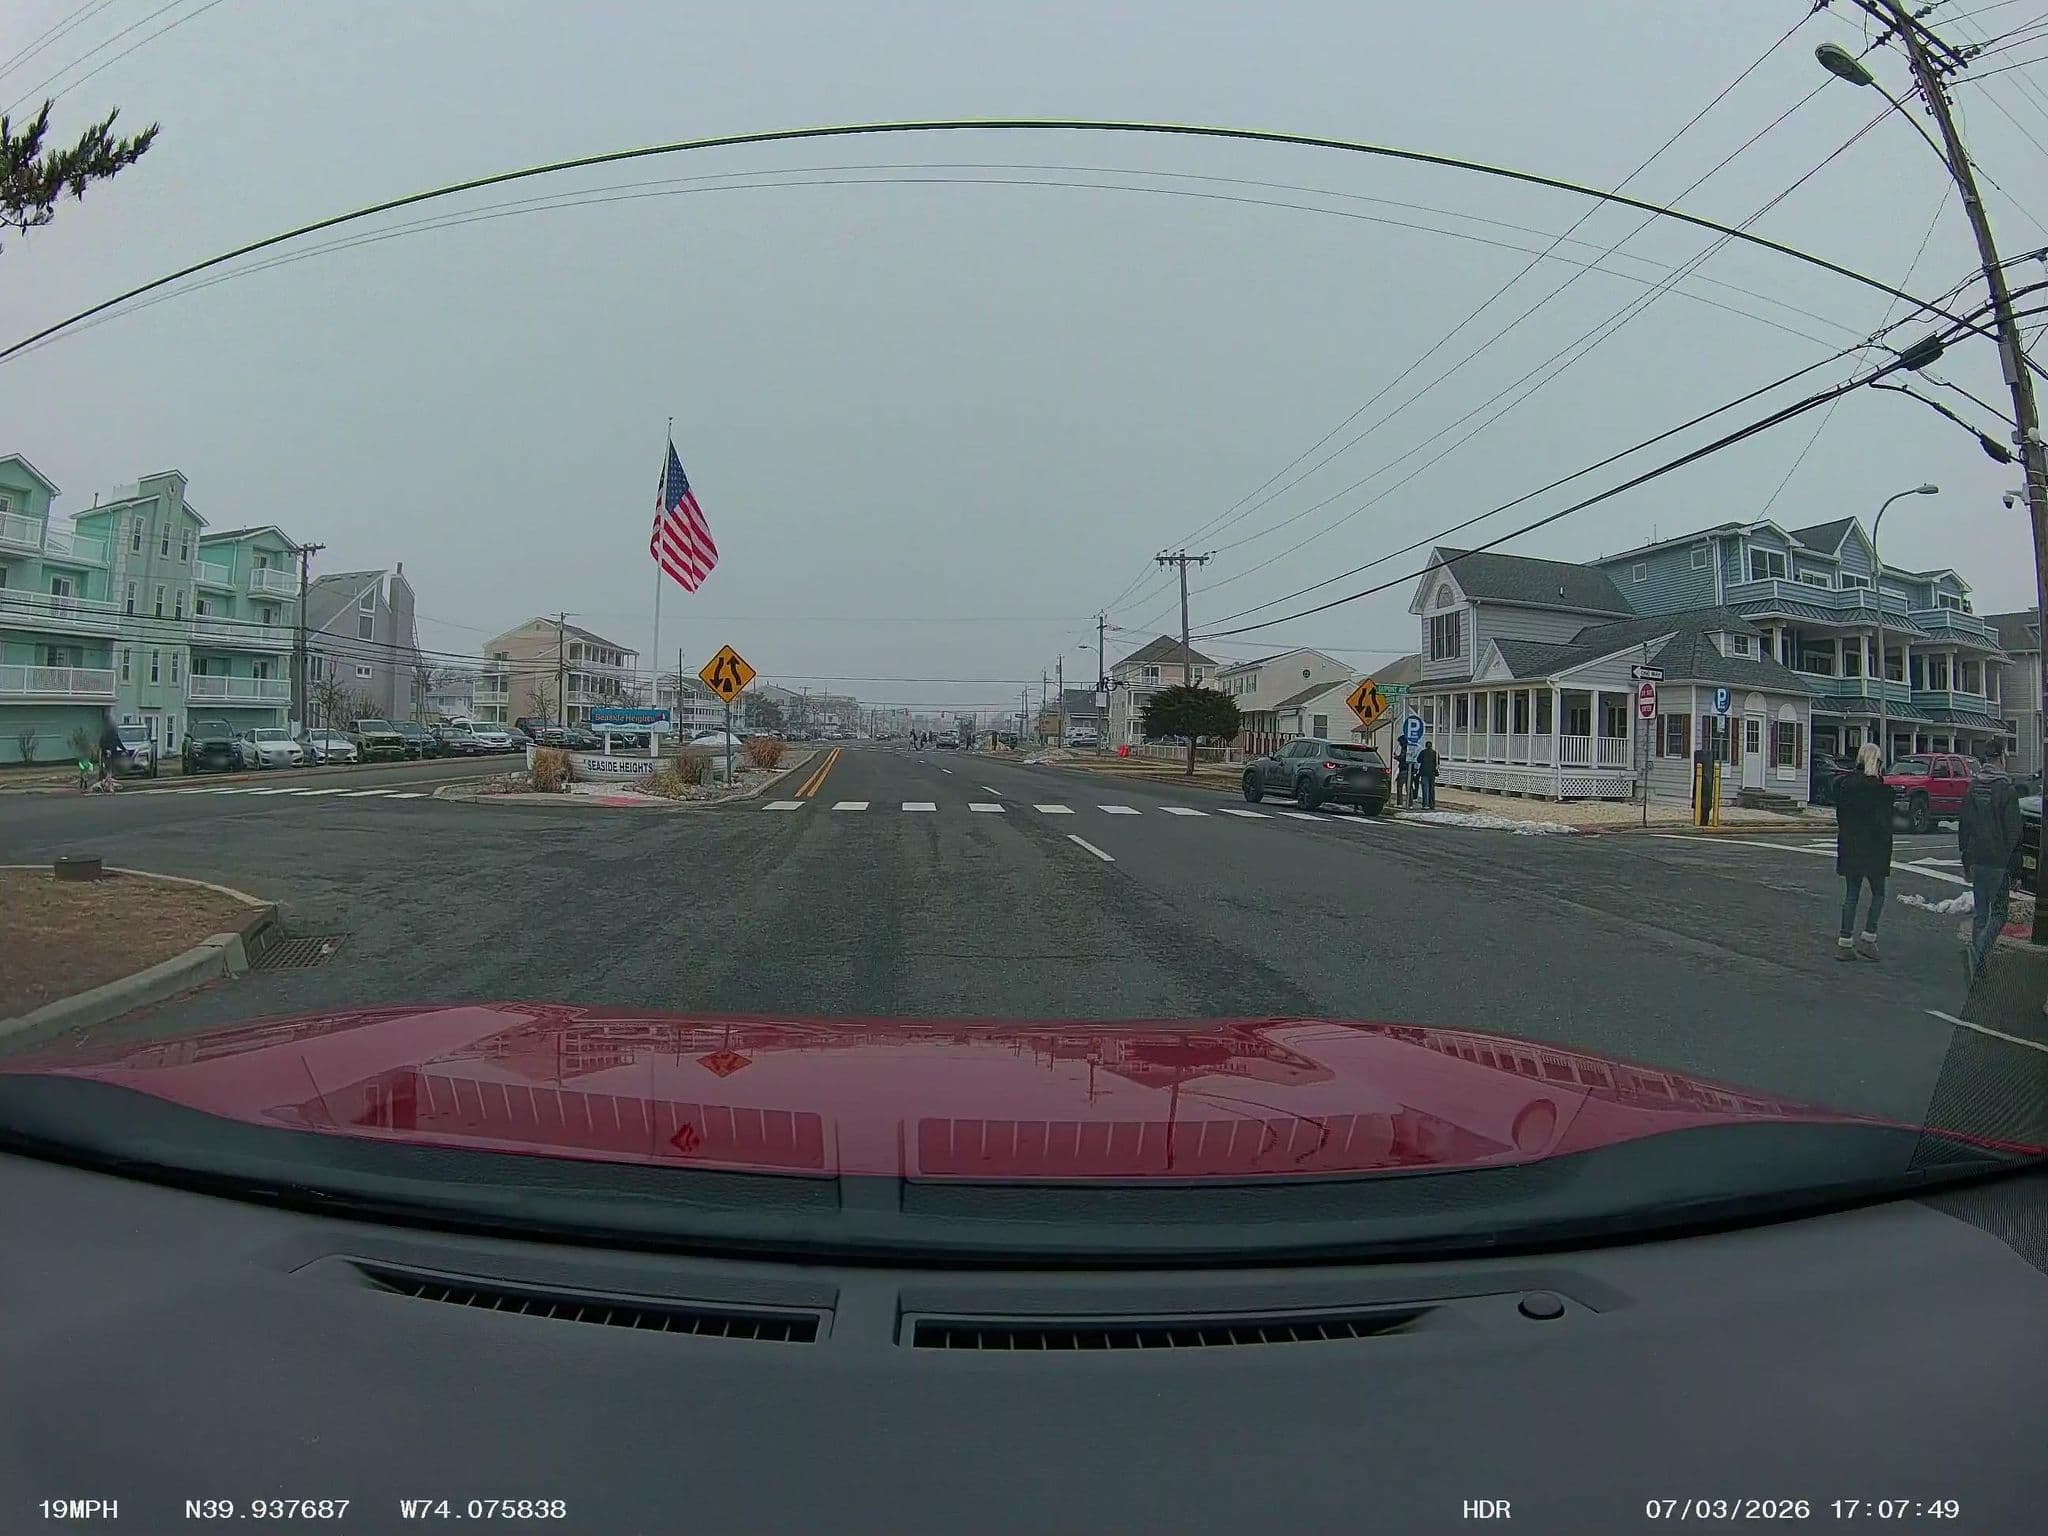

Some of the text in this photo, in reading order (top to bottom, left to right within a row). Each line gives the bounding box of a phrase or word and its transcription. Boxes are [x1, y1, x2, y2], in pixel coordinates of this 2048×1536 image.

[1717, 688, 1727, 709] P
[595, 713, 624, 721] Seaside
[1407, 719, 1420, 739] P
[587, 760, 654, 774] SEASIDE HEIGHTS
